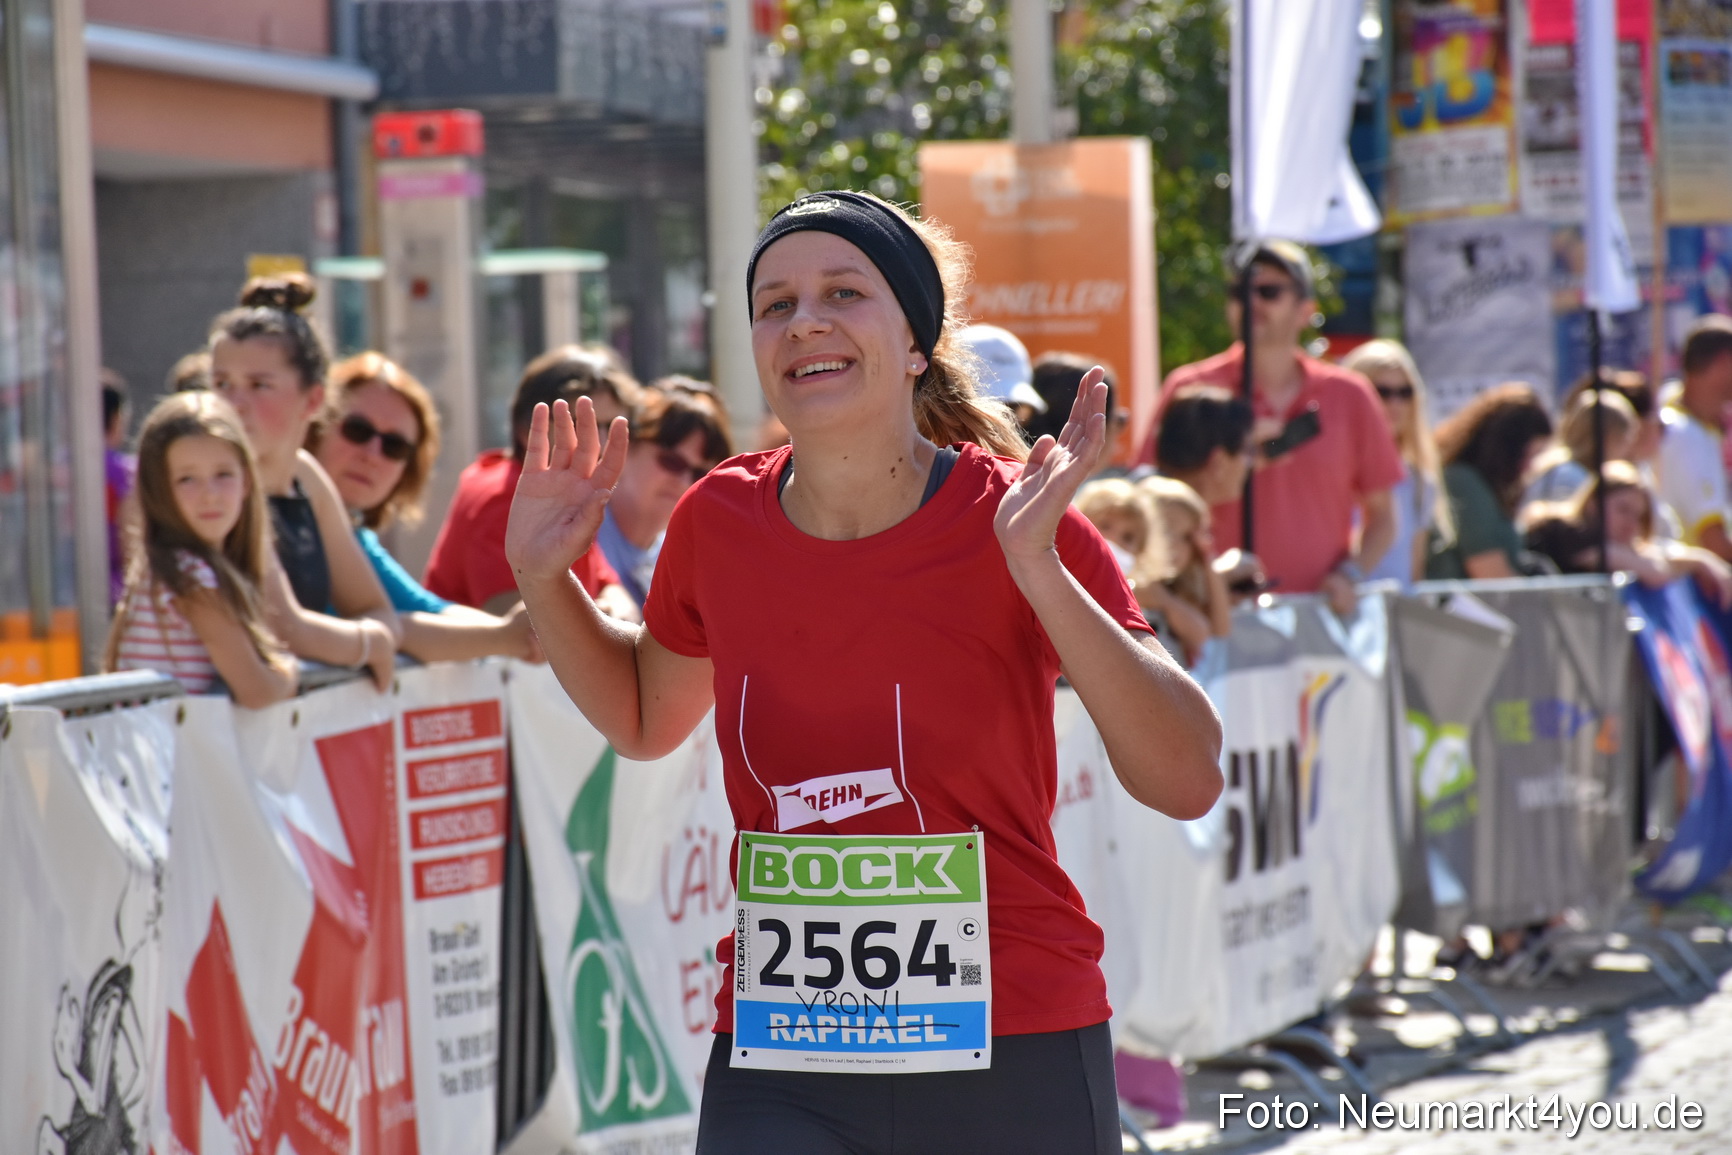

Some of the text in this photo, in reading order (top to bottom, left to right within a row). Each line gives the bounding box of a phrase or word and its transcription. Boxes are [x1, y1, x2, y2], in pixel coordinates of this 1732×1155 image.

[970, 280, 1124, 317] HNELLER!
[803, 783, 863, 812] DEHN
[751, 845, 957, 895] BOCK
[963, 923, 975, 936] C
[758, 918, 957, 990] 2564
[796, 989, 901, 1017] VRONI
[769, 1012, 948, 1045] RAPHAEL
